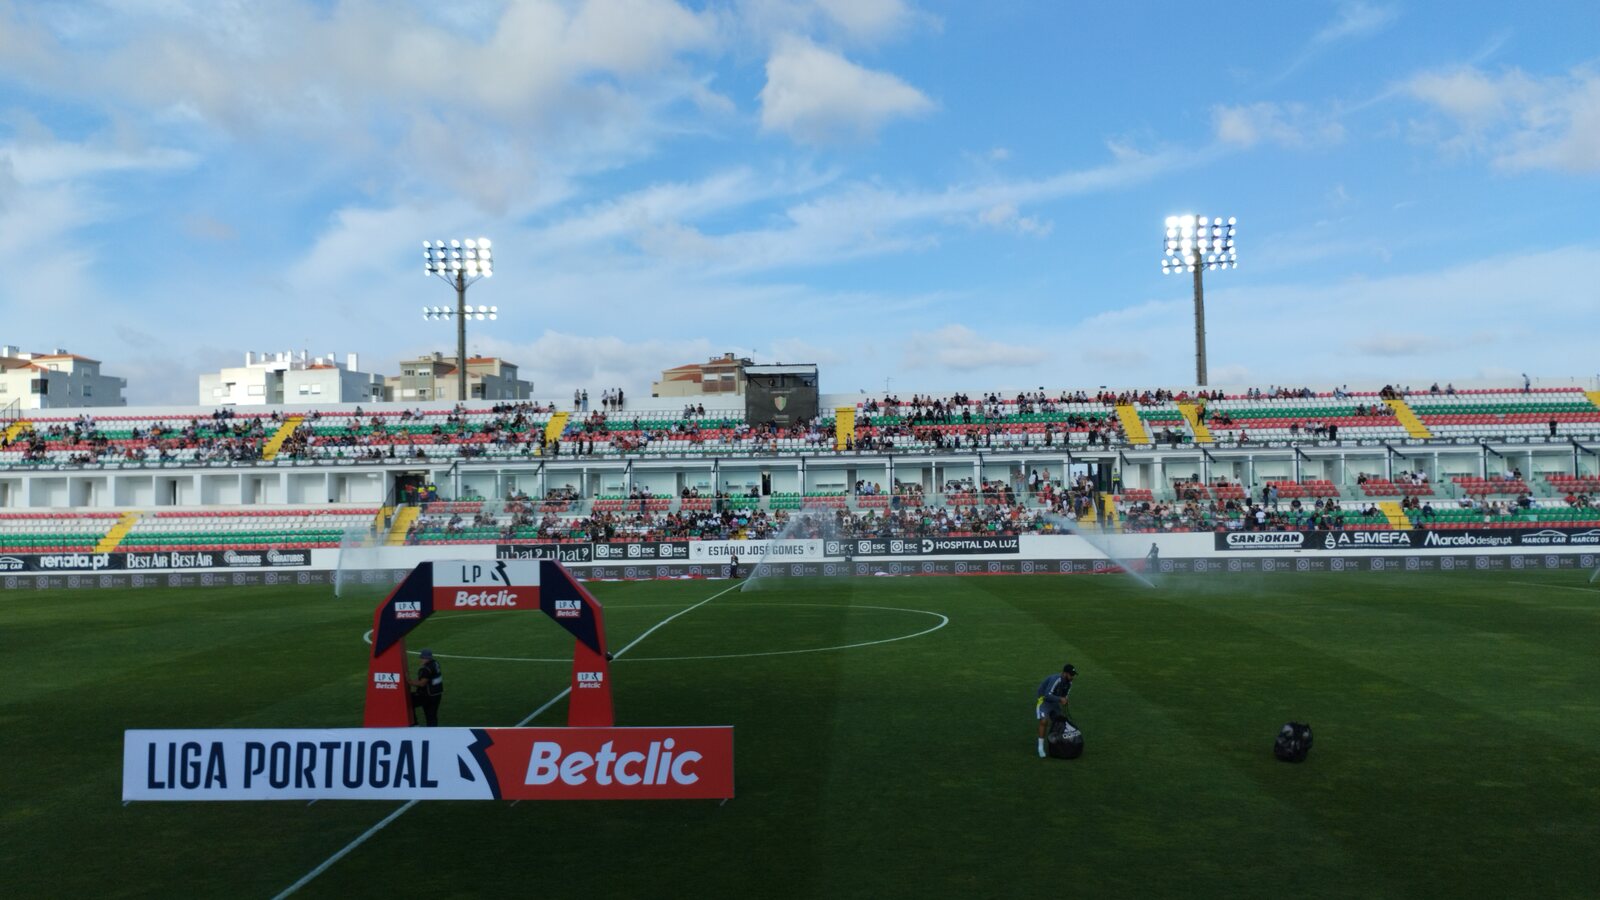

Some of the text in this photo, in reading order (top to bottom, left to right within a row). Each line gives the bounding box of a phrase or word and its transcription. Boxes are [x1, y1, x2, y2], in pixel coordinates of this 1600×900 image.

[936, 540, 1017, 550] HOSPITAL DA LUZ
[1337, 532, 1411, 543] A SMEFA
[708, 543, 804, 555] ESTÁDIO JOSÉ GOMES
[40, 553, 109, 570] renata.pt
[462, 565, 481, 583] LP
[455, 590, 518, 606] Betclic
[147, 737, 703, 790] LIGA PORTUGAL Betclic
